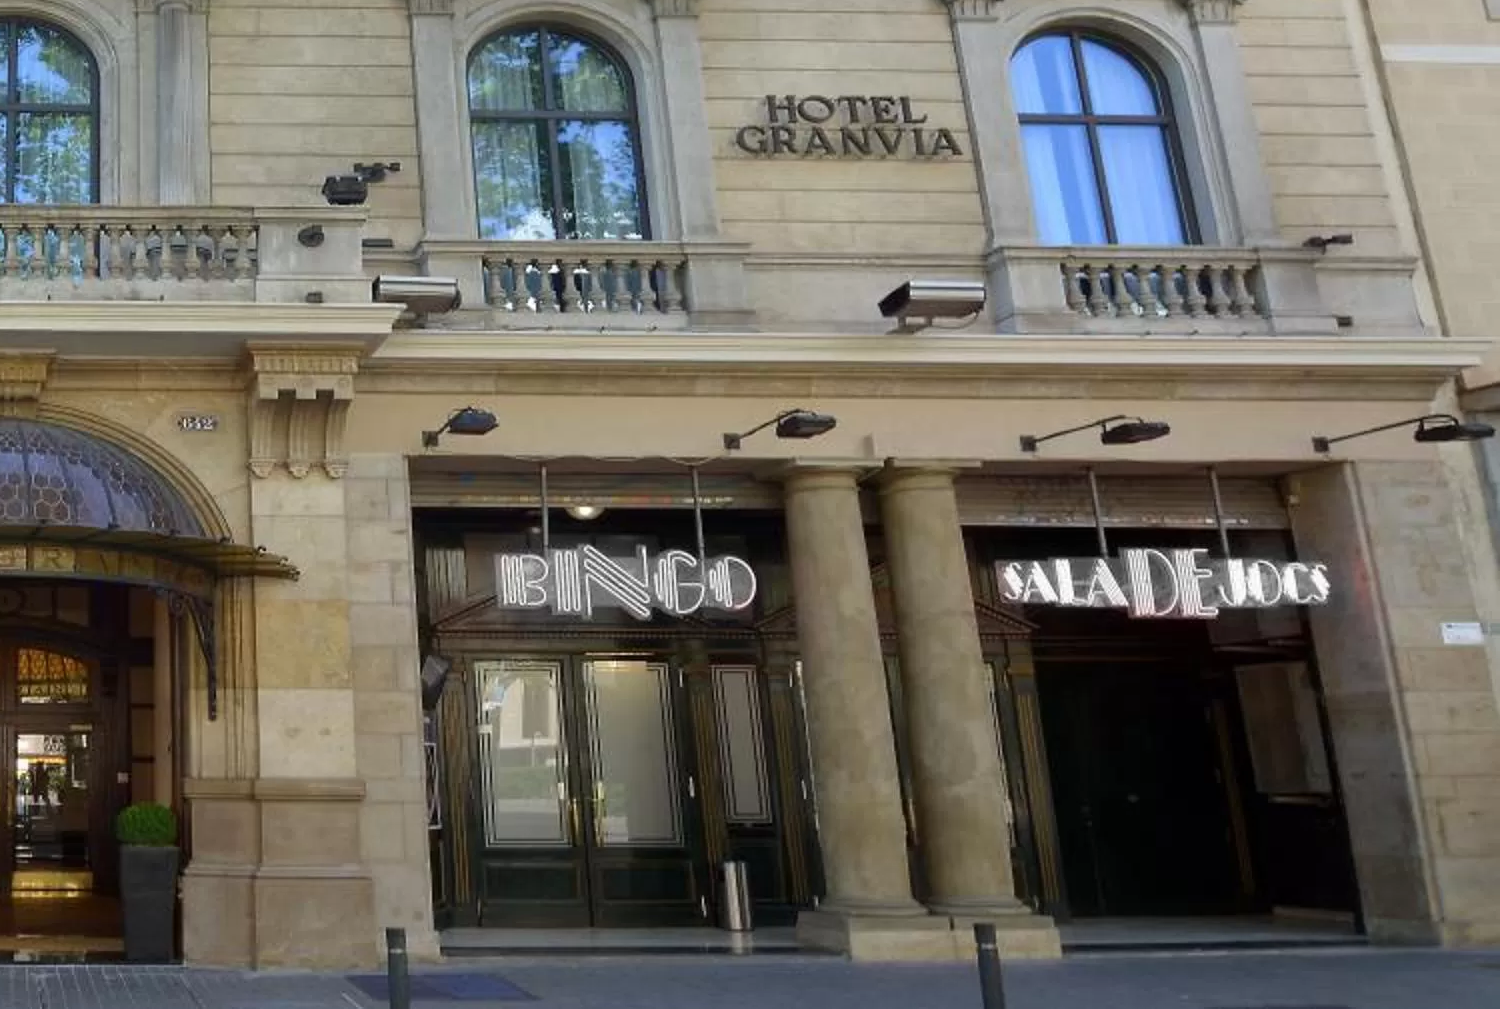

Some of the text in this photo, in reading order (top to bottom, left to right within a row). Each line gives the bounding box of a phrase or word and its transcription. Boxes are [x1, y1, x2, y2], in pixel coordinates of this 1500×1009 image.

[765, 94, 928, 124] HOTEL
[735, 125, 964, 156] GRANVIA
[501, 544, 757, 617] BINGO
[1002, 548, 1331, 617] SALA DE JOCS
